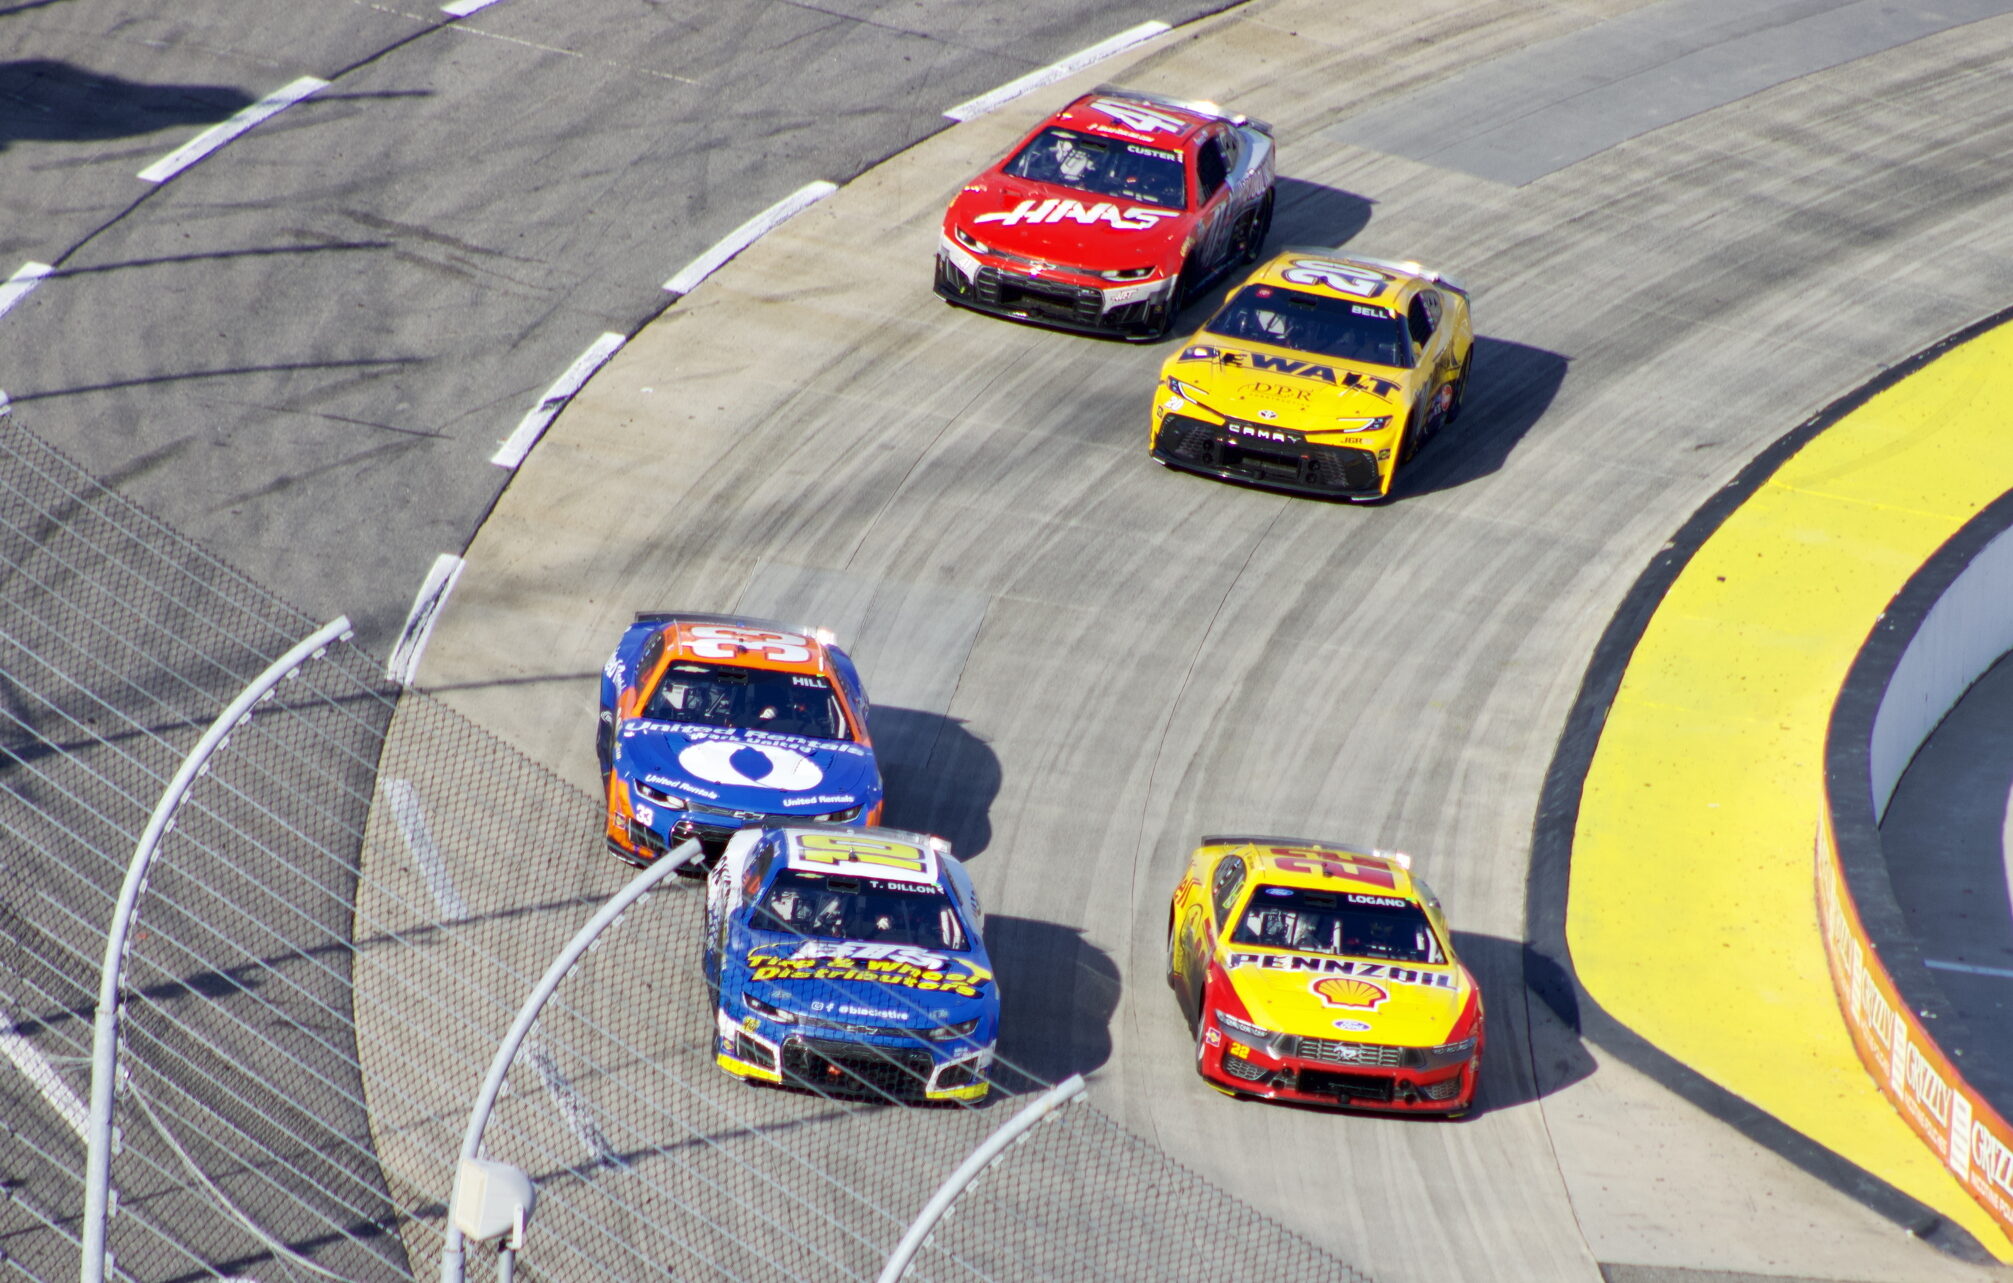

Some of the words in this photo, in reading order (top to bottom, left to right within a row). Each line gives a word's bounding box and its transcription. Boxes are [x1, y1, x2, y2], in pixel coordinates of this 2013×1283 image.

[1127, 144, 1176, 163] CUSTER
[974, 198, 1180, 230] HAAS
[1282, 259, 1391, 298] 20
[1351, 304, 1388, 319] BELL
[1178, 346, 1401, 398] DEWALT
[1253, 381, 1312, 402] DPR
[1164, 395, 1184, 412] 20
[1228, 423, 1301, 443] CAMRY
[681, 626, 812, 662] 33
[792, 676, 828, 689] HILL
[624, 721, 736, 736] United
[743, 730, 865, 756] Rentals
[690, 732, 740, 743] Work
[645, 774, 679, 789] United
[680, 781, 720, 800] Rentals
[784, 797, 816, 807] United
[818, 795, 854, 804] Rentals
[636, 805, 653, 827] 33
[1270, 848, 1395, 890] 22
[869, 880, 884, 889] T.
[887, 882, 936, 895] DILLON
[1348, 894, 1406, 908] LOGANO
[747, 956, 817, 970] Tire
[866, 959, 992, 985] Wheel
[1229, 953, 1460, 990] PENNZOIL
[752, 966, 978, 998] Distributors
[838, 1005, 909, 1020] @blackstire
[1230, 1042, 1250, 1060] 22
[1906, 1040, 1952, 1129] GRIZZLY
